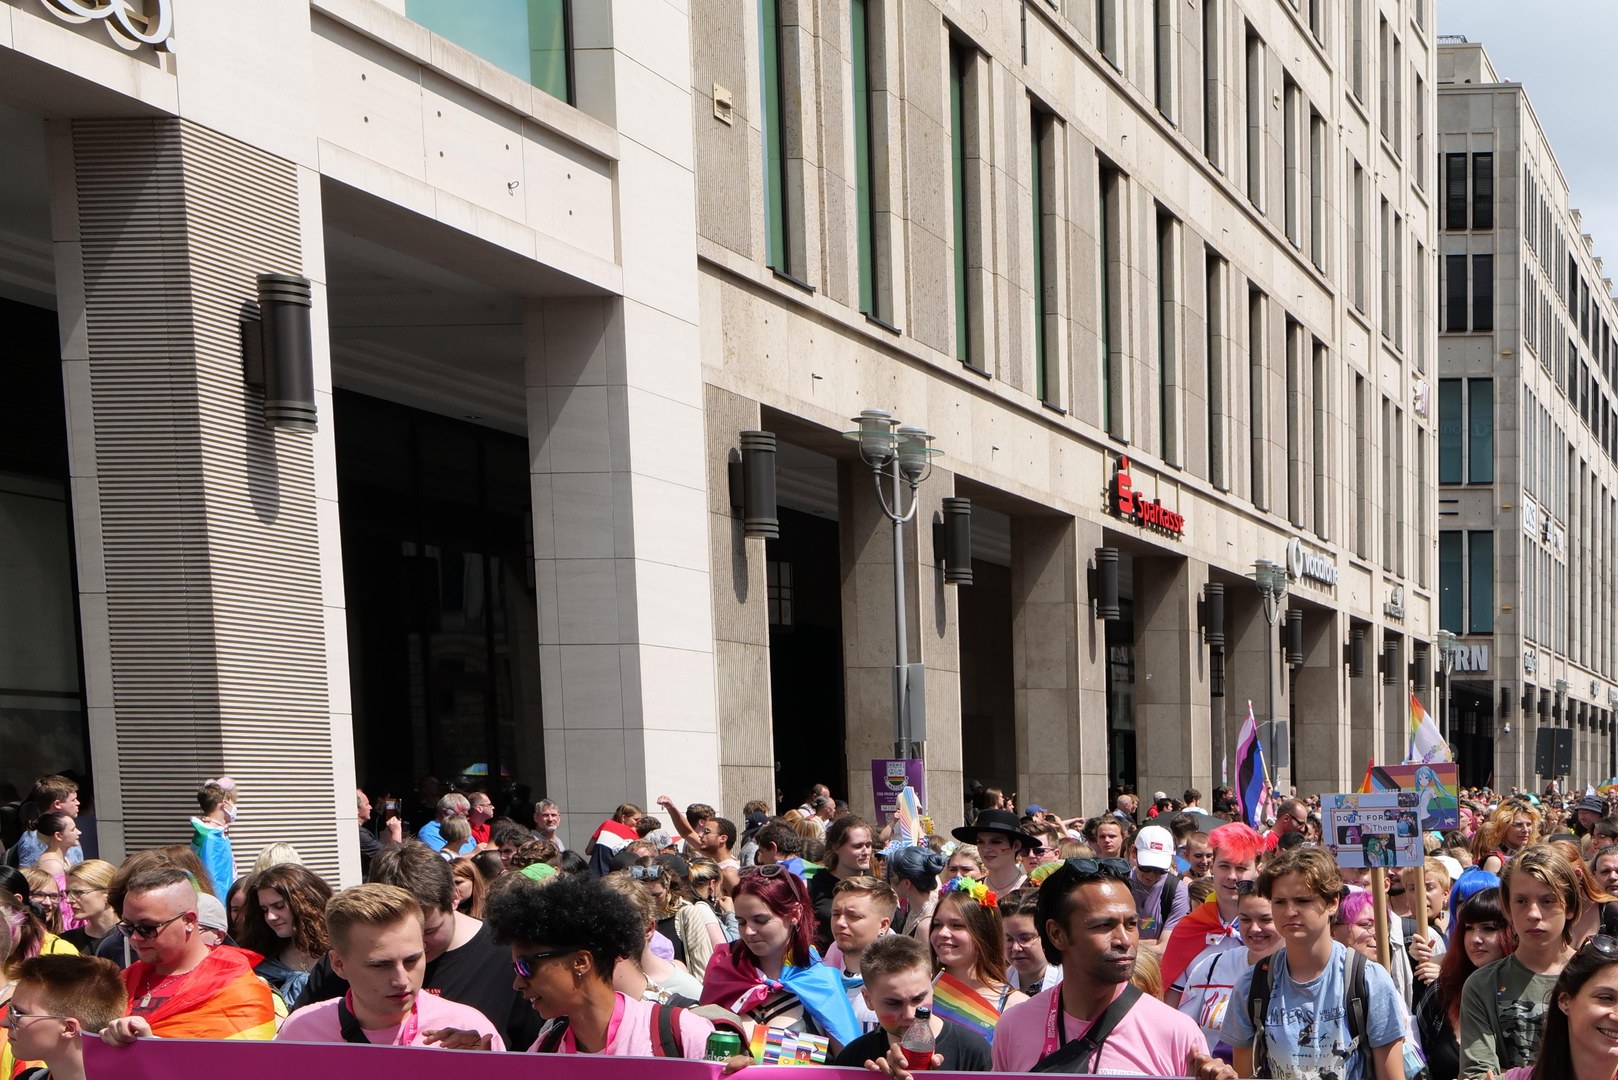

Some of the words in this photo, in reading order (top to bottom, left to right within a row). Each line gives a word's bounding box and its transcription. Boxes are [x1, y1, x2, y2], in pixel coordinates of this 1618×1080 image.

[1137, 491, 1184, 534] Sparkasse
[1455, 645, 1488, 671] RN
[1373, 824, 1395, 832] Them
